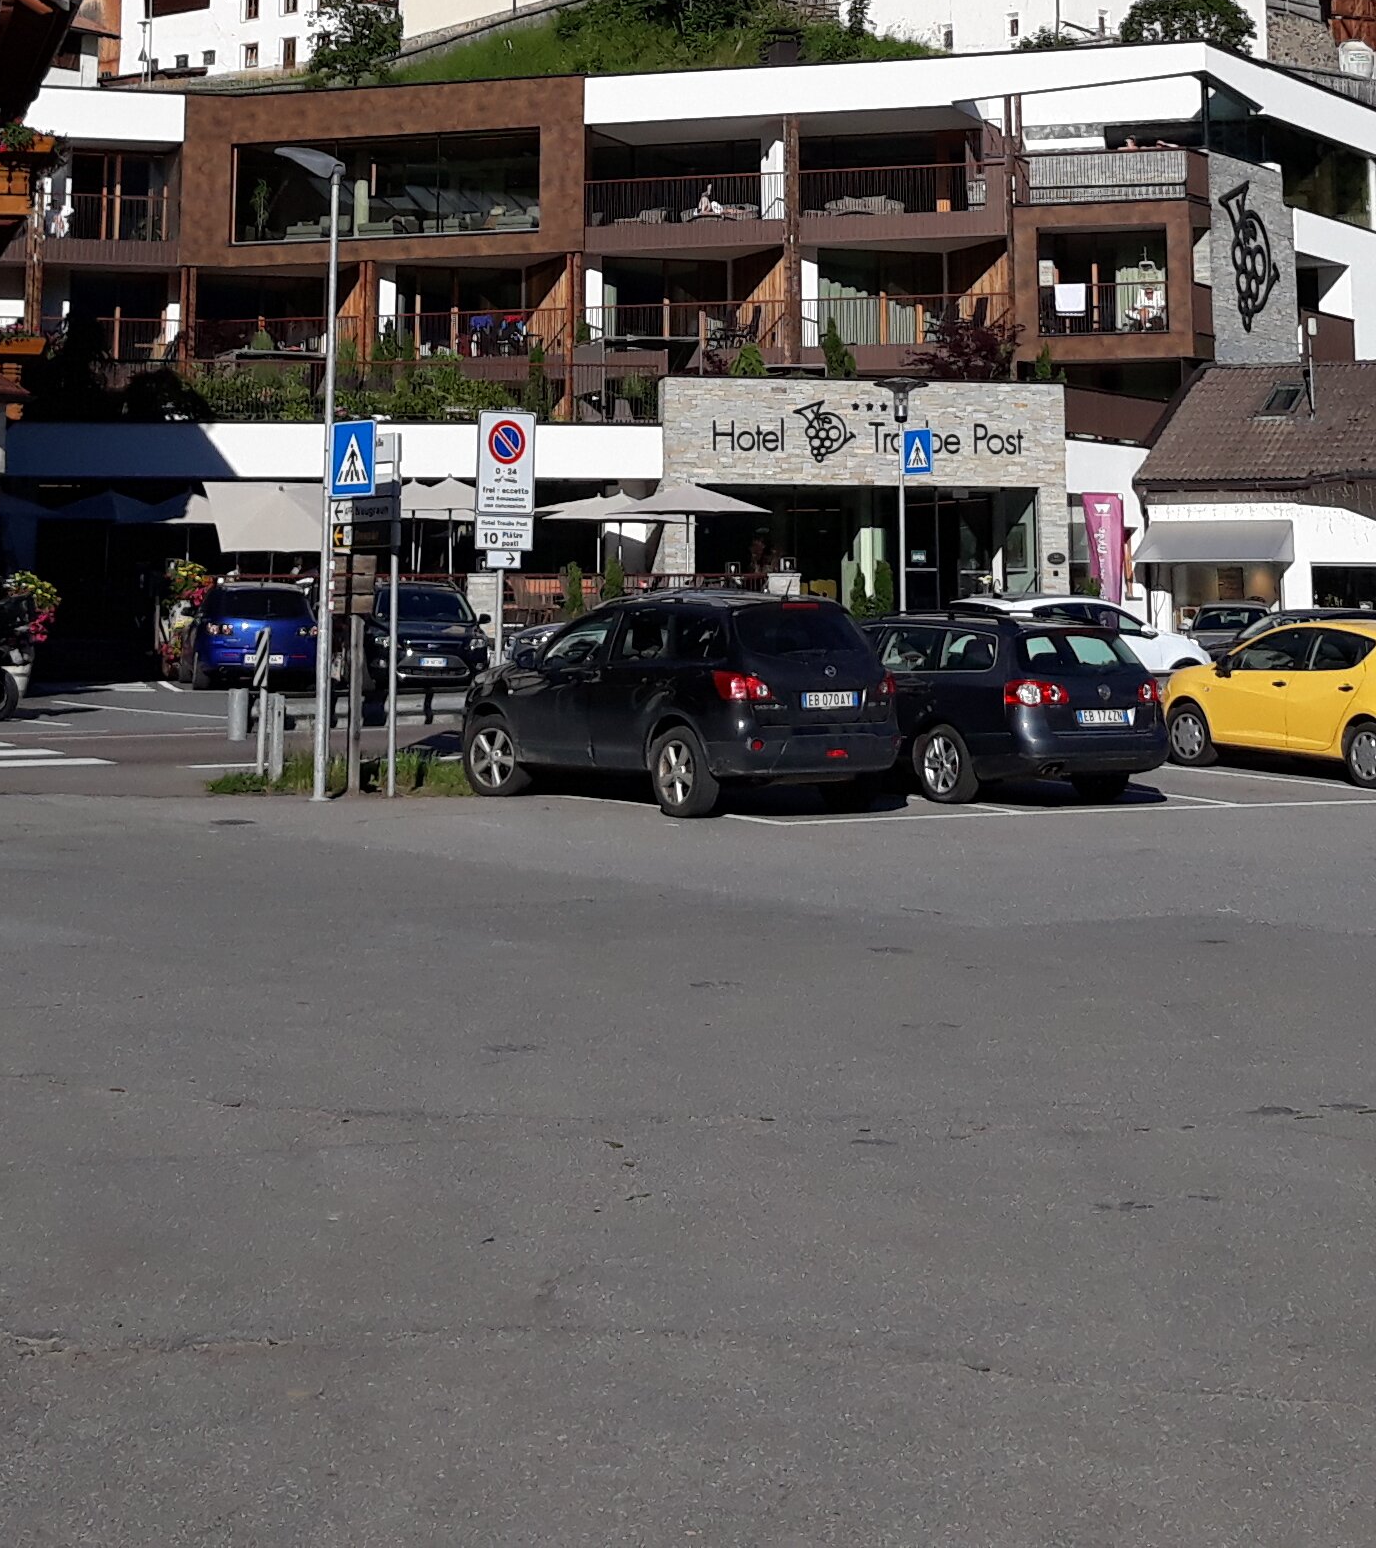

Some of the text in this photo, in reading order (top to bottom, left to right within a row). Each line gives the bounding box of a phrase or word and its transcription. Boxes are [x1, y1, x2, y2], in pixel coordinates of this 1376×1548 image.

[712, 418, 784, 452] Hotel
[973, 423, 1024, 455] Post
[483, 531, 499, 545] 10
